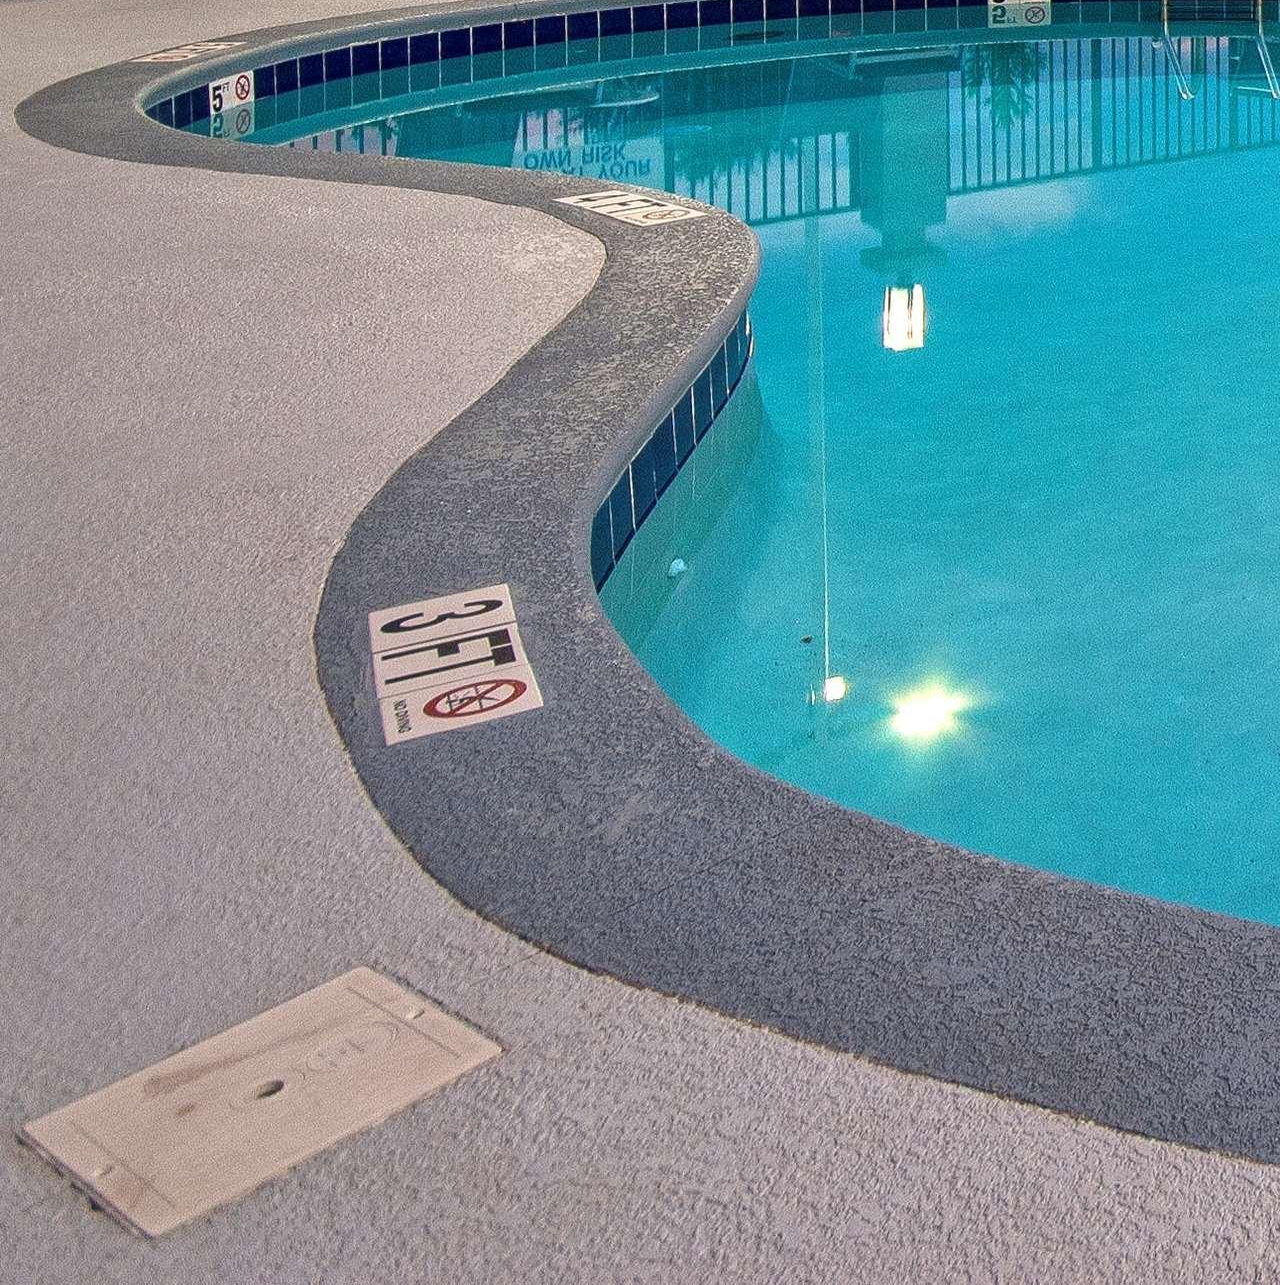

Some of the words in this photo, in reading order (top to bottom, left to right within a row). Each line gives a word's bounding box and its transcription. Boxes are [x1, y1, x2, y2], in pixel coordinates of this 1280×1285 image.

[212, 86, 223, 113] 5
[380, 599, 503, 633] 3
[381, 628, 517, 685] FT
